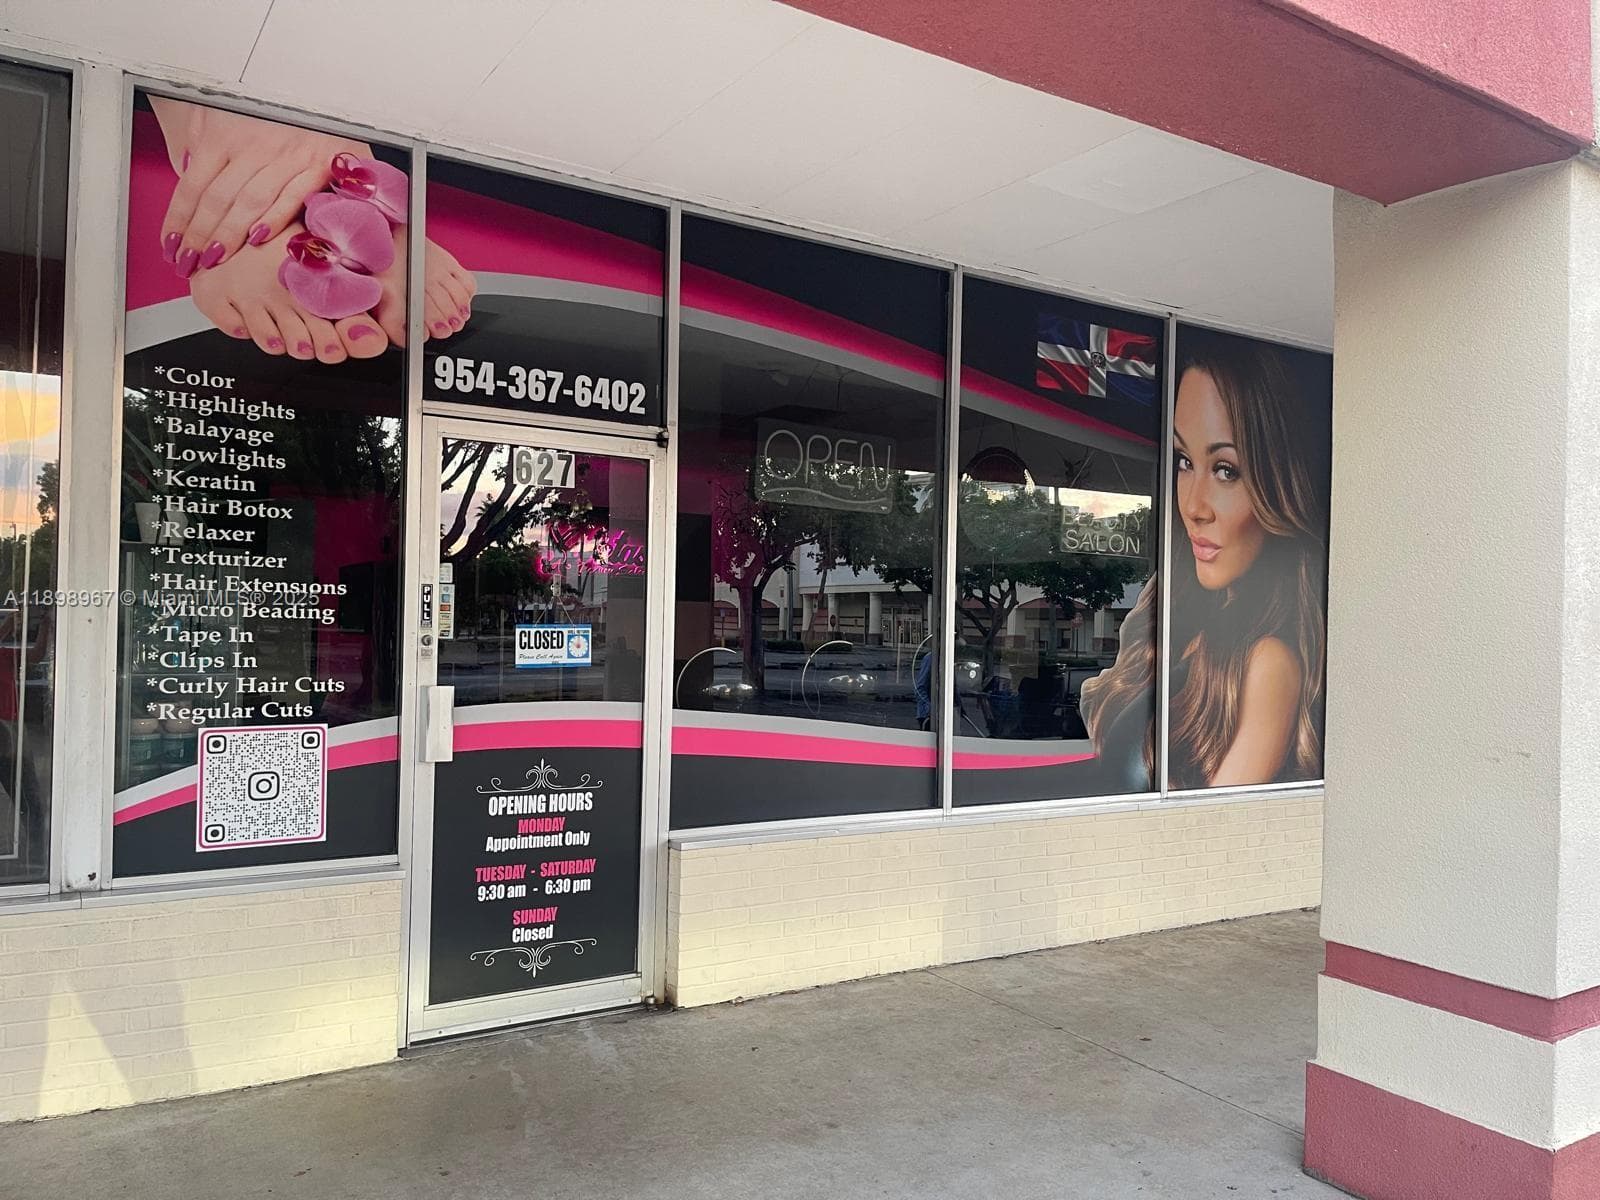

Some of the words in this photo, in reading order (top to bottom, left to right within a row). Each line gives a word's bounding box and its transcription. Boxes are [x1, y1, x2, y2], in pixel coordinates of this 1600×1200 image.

[434, 355, 646, 415] 954-367-6402
[515, 450, 573, 486] 627
[764, 429, 893, 493] OPEN
[227, 499, 294, 520] Botox
[1064, 529, 1140, 554] SALON
[224, 575, 348, 596] Extensions
[423, 586, 431, 620] PULL
[241, 603, 336, 625] Beading
[228, 626, 254, 643] In
[519, 630, 564, 650] CLOSED
[232, 652, 258, 668] In
[236, 677, 289, 694] Hair
[294, 676, 345, 694] Cuts
[261, 702, 313, 718] Cuts
[488, 794, 547, 816] OPENING
[548, 791, 593, 812] HOURS
[518, 817, 566, 834] MONDAY
[485, 832, 564, 853] Appointment
[564, 830, 591, 847] Only
[475, 864, 527, 882] TUESDAY
[540, 858, 597, 877] SATURDAY
[477, 885, 505, 902] 9:30
[506, 884, 526, 898] am
[544, 879, 571, 895] 6:30
[573, 878, 591, 893] pm
[512, 907, 558, 925] SUNDAY
[512, 924, 554, 943] Closed
